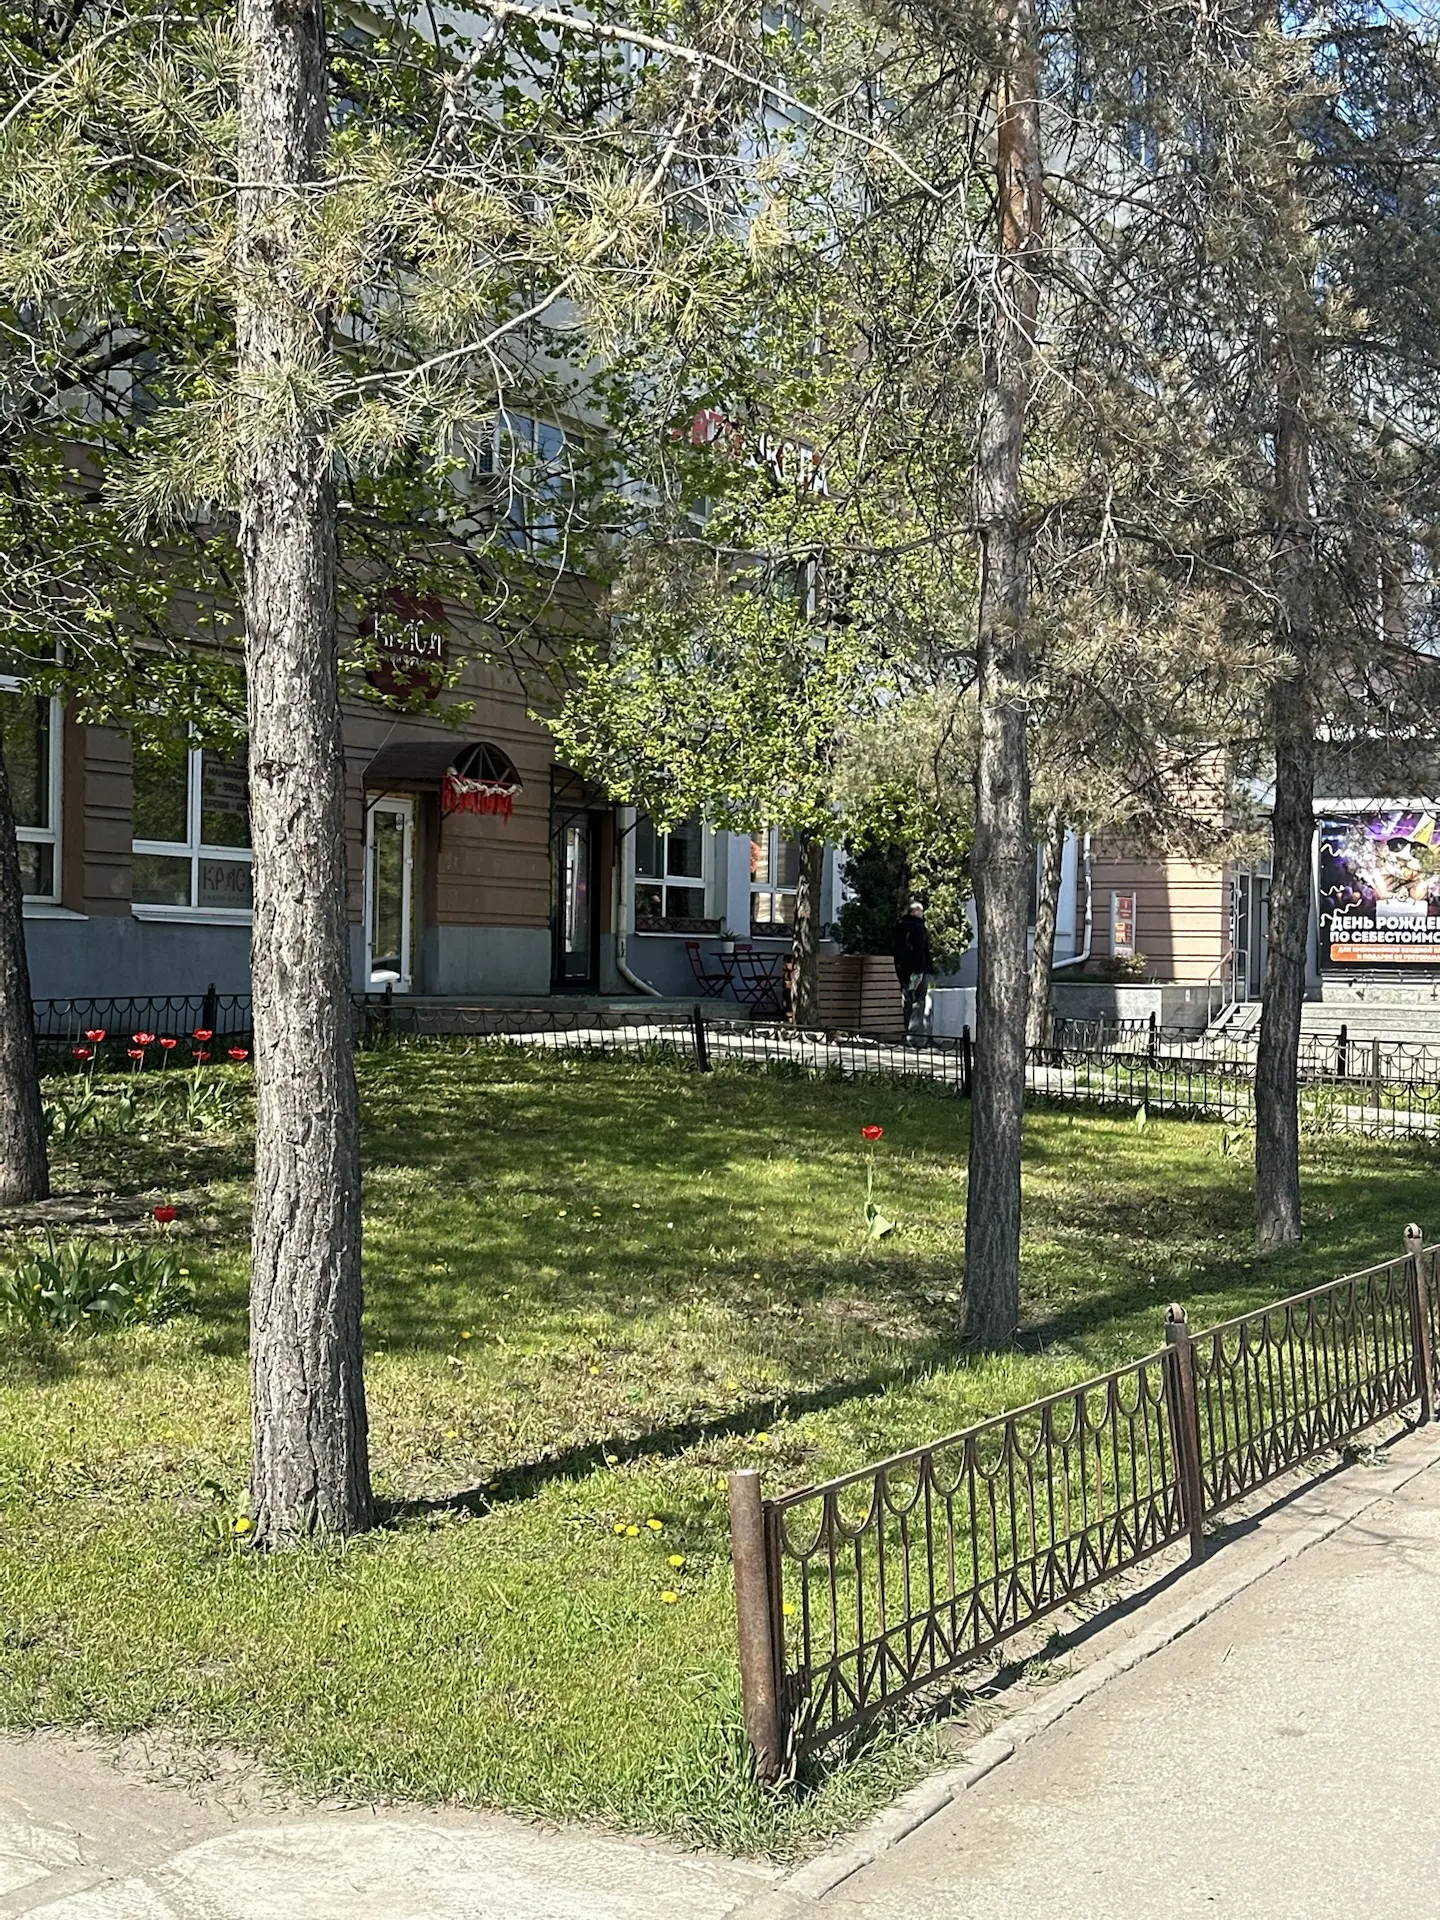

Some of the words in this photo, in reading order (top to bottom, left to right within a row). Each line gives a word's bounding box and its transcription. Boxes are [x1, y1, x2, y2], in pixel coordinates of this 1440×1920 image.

[1330, 916, 1374, 931] ДЕНЬ
[1330, 931, 1350, 943] ПО
[1351, 931, 1440, 943] СЕБЕСТОИМС
